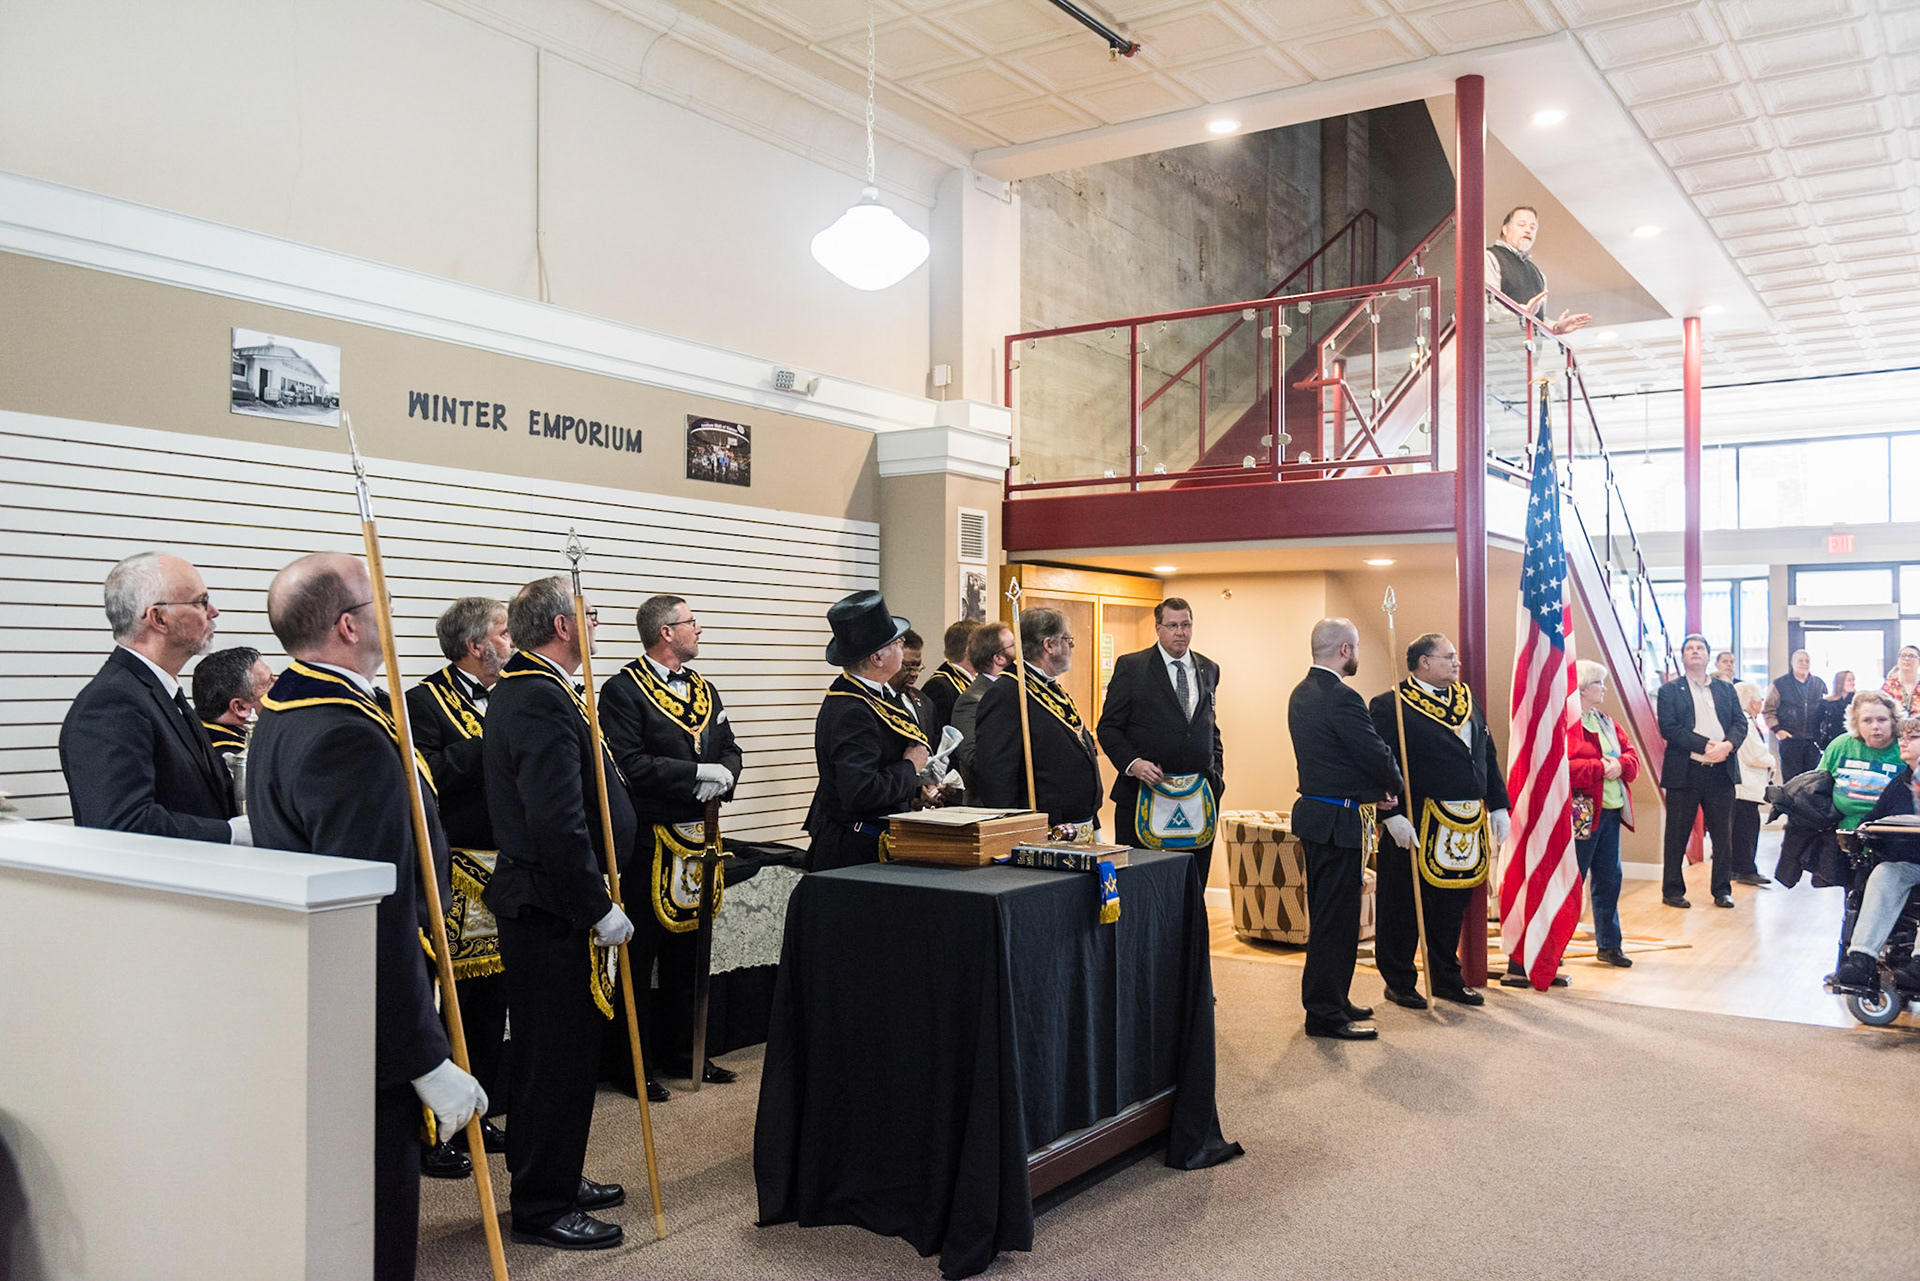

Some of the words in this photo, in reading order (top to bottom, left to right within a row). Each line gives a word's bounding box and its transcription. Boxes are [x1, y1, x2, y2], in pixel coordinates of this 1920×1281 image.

[408, 390, 507, 431] WINTER
[529, 410, 642, 453] EMPORIUM
[1828, 535, 1856, 553] EXIT
